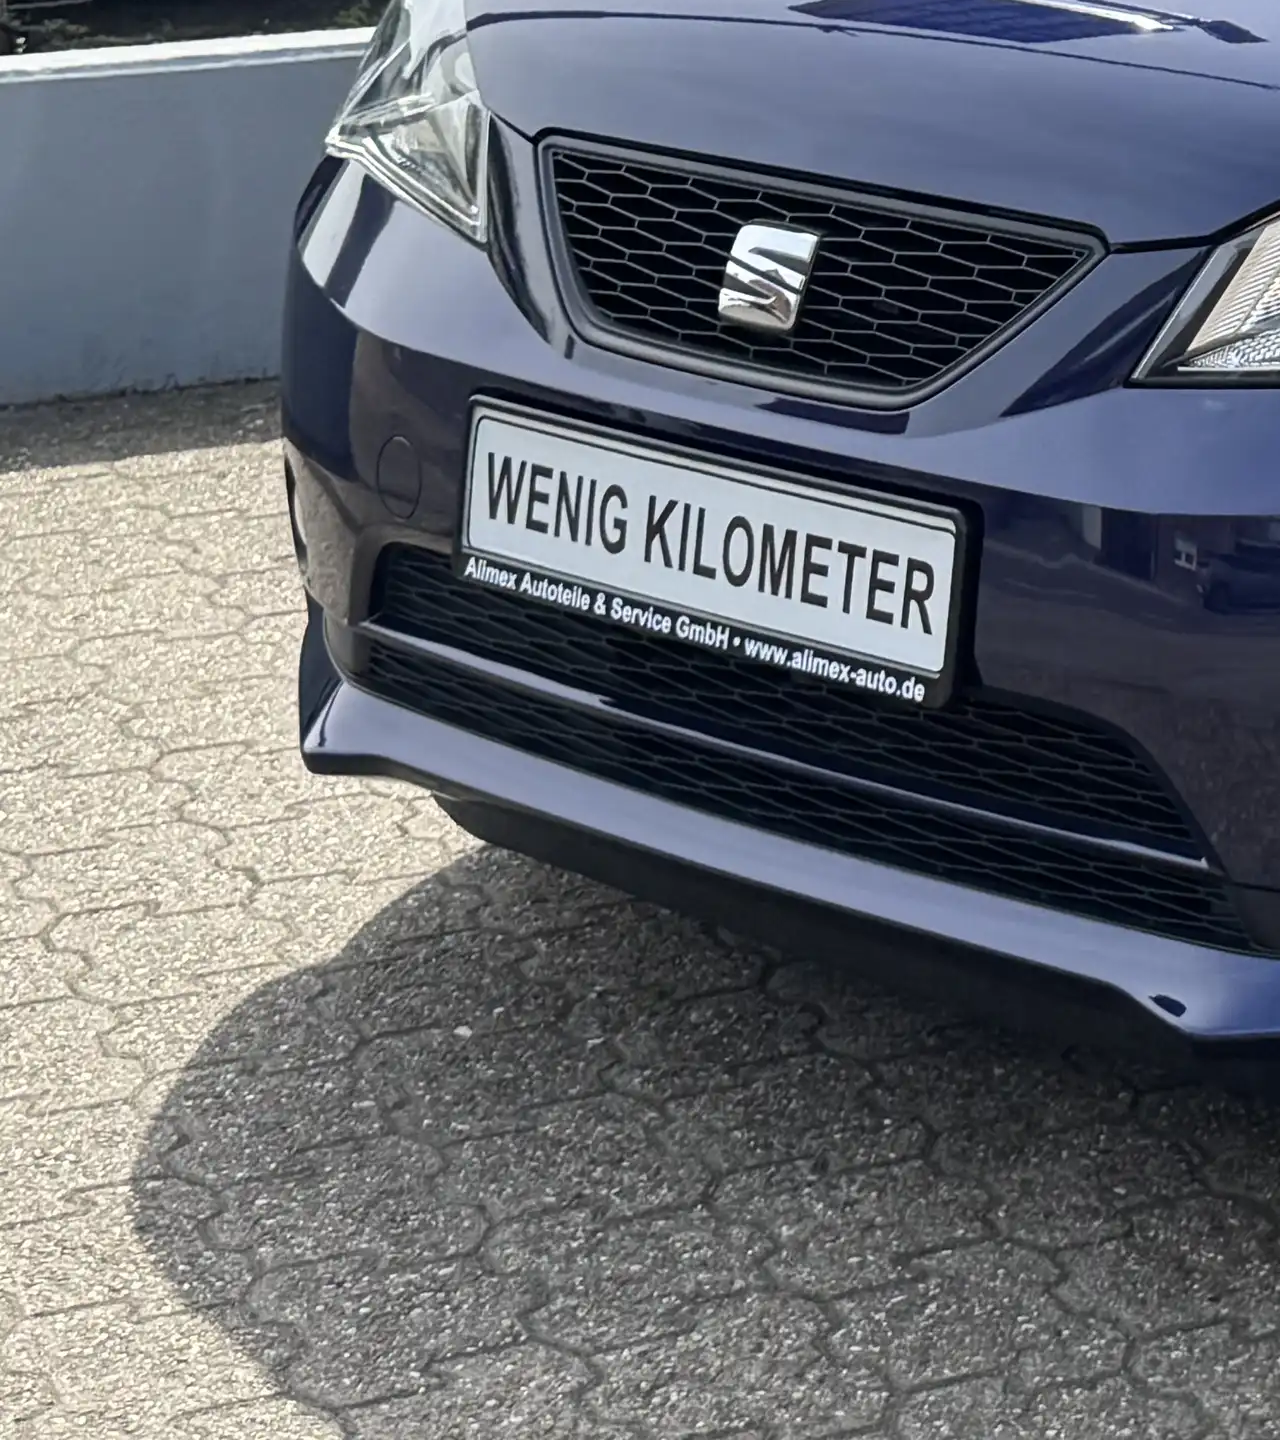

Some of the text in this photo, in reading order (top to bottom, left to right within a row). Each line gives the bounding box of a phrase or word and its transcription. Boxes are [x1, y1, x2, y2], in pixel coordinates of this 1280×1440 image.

[487, 451, 935, 636] WENIG KILOMETER
[464, 556, 926, 702] Alimex Autoteile & Service GmbH www.alimex-auto.de
